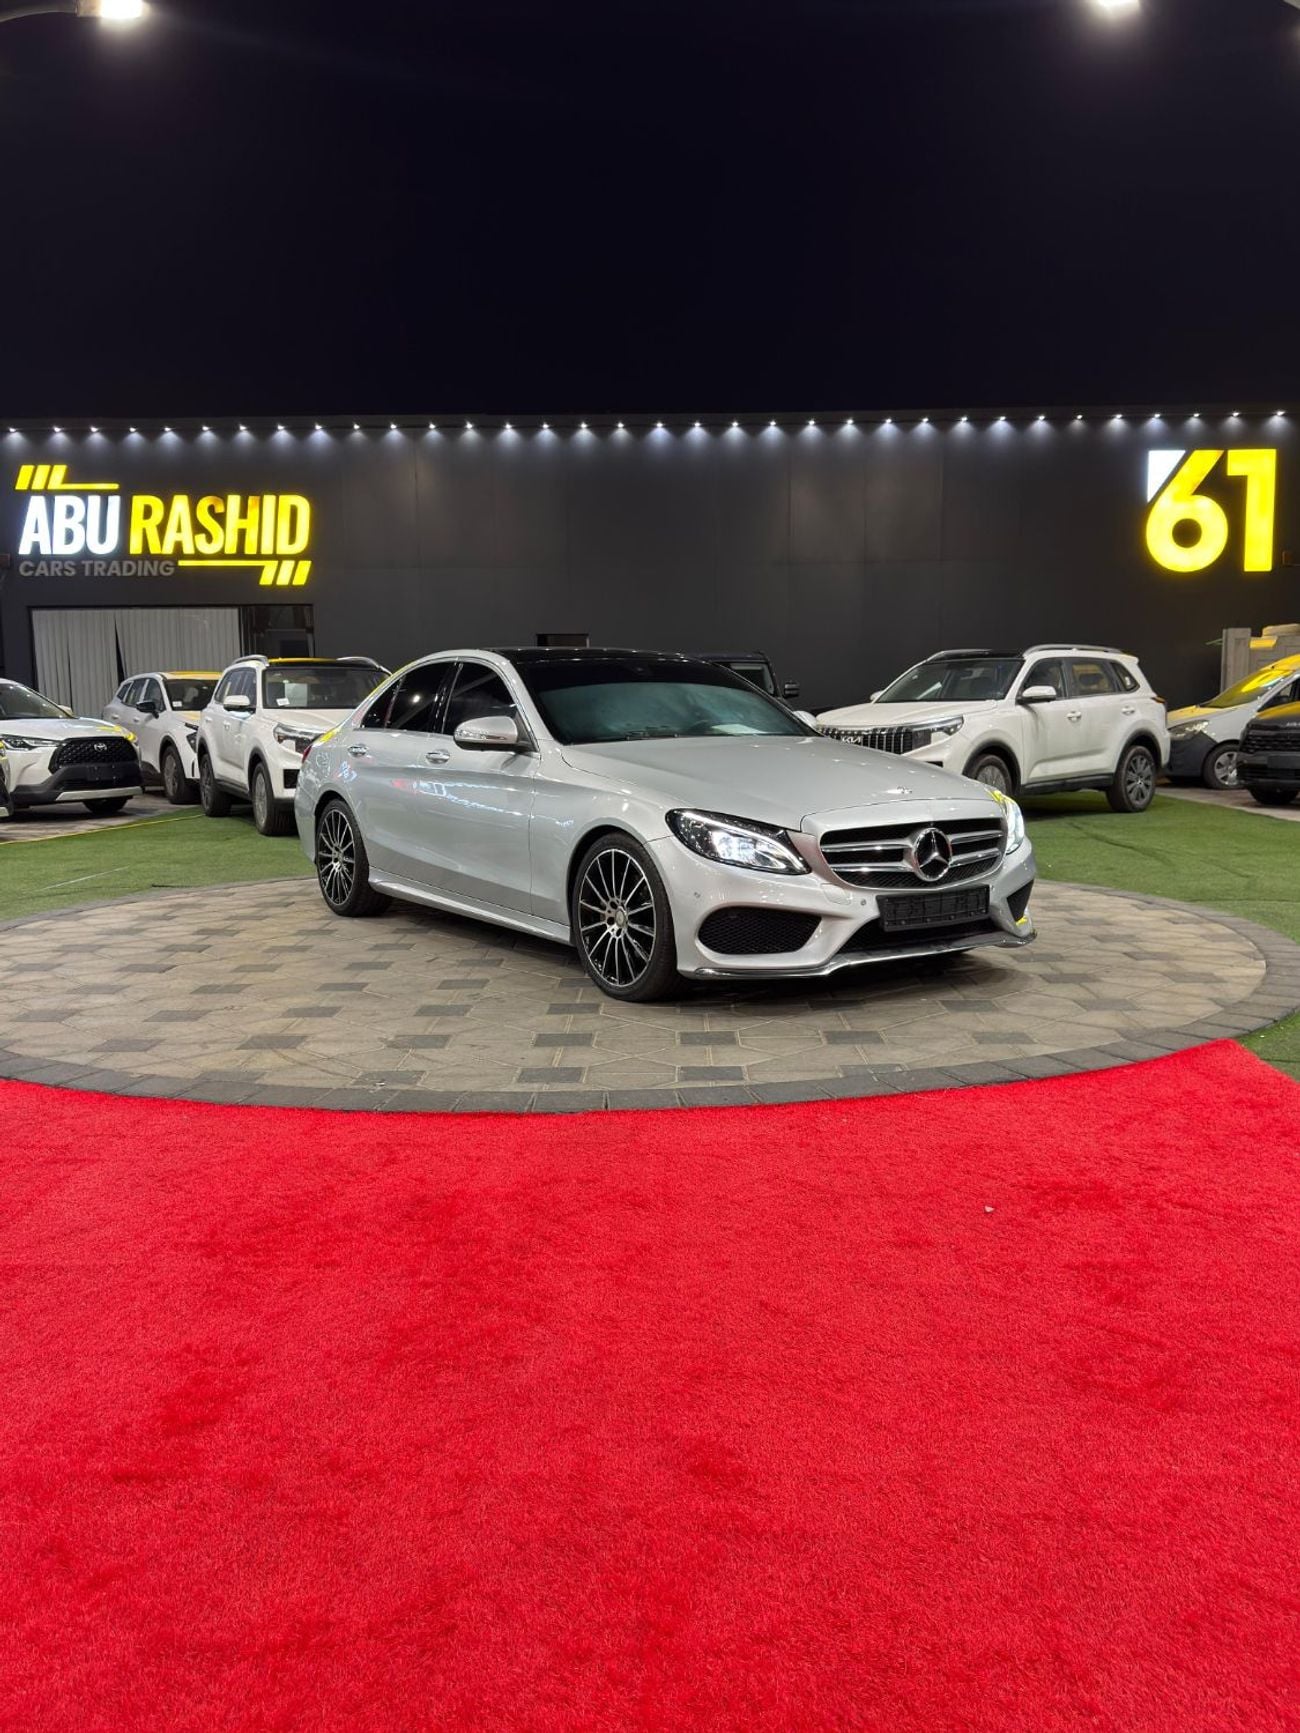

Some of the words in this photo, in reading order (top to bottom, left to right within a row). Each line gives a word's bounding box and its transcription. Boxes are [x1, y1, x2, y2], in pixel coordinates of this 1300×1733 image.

[18, 495, 121, 555] ABU
[129, 494, 310, 555] RASHID
[1146, 449, 1277, 573] 61
[19, 560, 76, 577] CARS
[81, 560, 175, 577] TRADING
